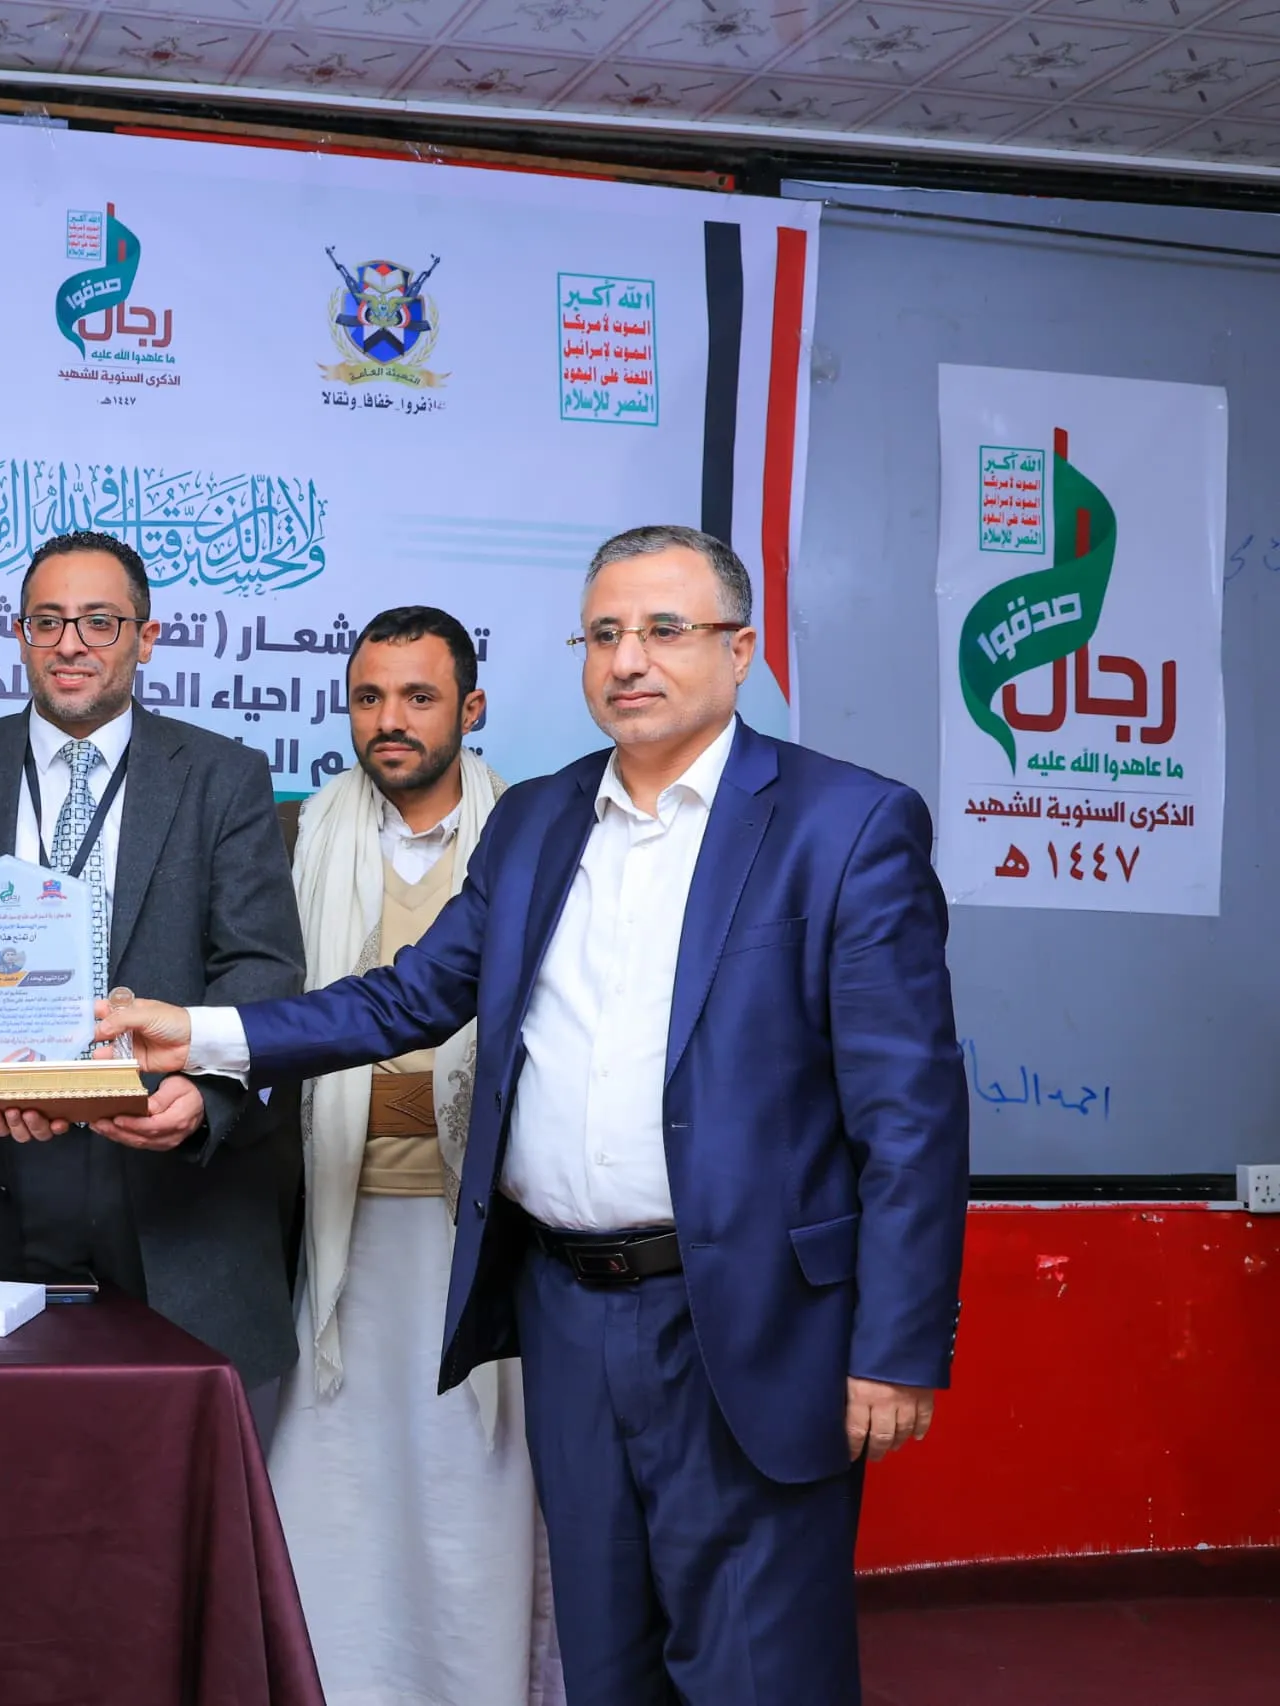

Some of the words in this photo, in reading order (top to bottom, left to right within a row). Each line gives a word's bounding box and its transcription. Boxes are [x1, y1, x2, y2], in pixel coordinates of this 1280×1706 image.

[65, 277, 122, 310] صدقوا
[618, 286, 651, 310] الله
[78, 300, 173, 348] رجال
[613, 320, 651, 337] الموت
[91, 349, 112, 361] عليه
[113, 348, 130, 360] الله
[131, 352, 164, 365] عاهدوا
[165, 353, 176, 364] ما
[614, 345, 652, 362] الموت
[58, 367, 99, 381] للشهيد
[100, 370, 144, 385] السنوية
[145, 374, 181, 388] الذكرى
[601, 368, 619, 385] على
[614, 390, 654, 416] النصر
[977, 592, 1082, 665] صدقوا
[133, 670, 200, 716] الجا
[211, 674, 301, 722] احياء
[1002, 641, 1177, 745] رجال
[1027, 750, 1066, 776] عليه
[1070, 748, 1099, 773] الله
[1104, 755, 1162, 781] عاهدوا
[1166, 757, 1184, 779] ما
[964, 791, 1042, 823] للشهيد
[1046, 796, 1126, 828] السنوية
[1130, 801, 1194, 832] الذكرى
